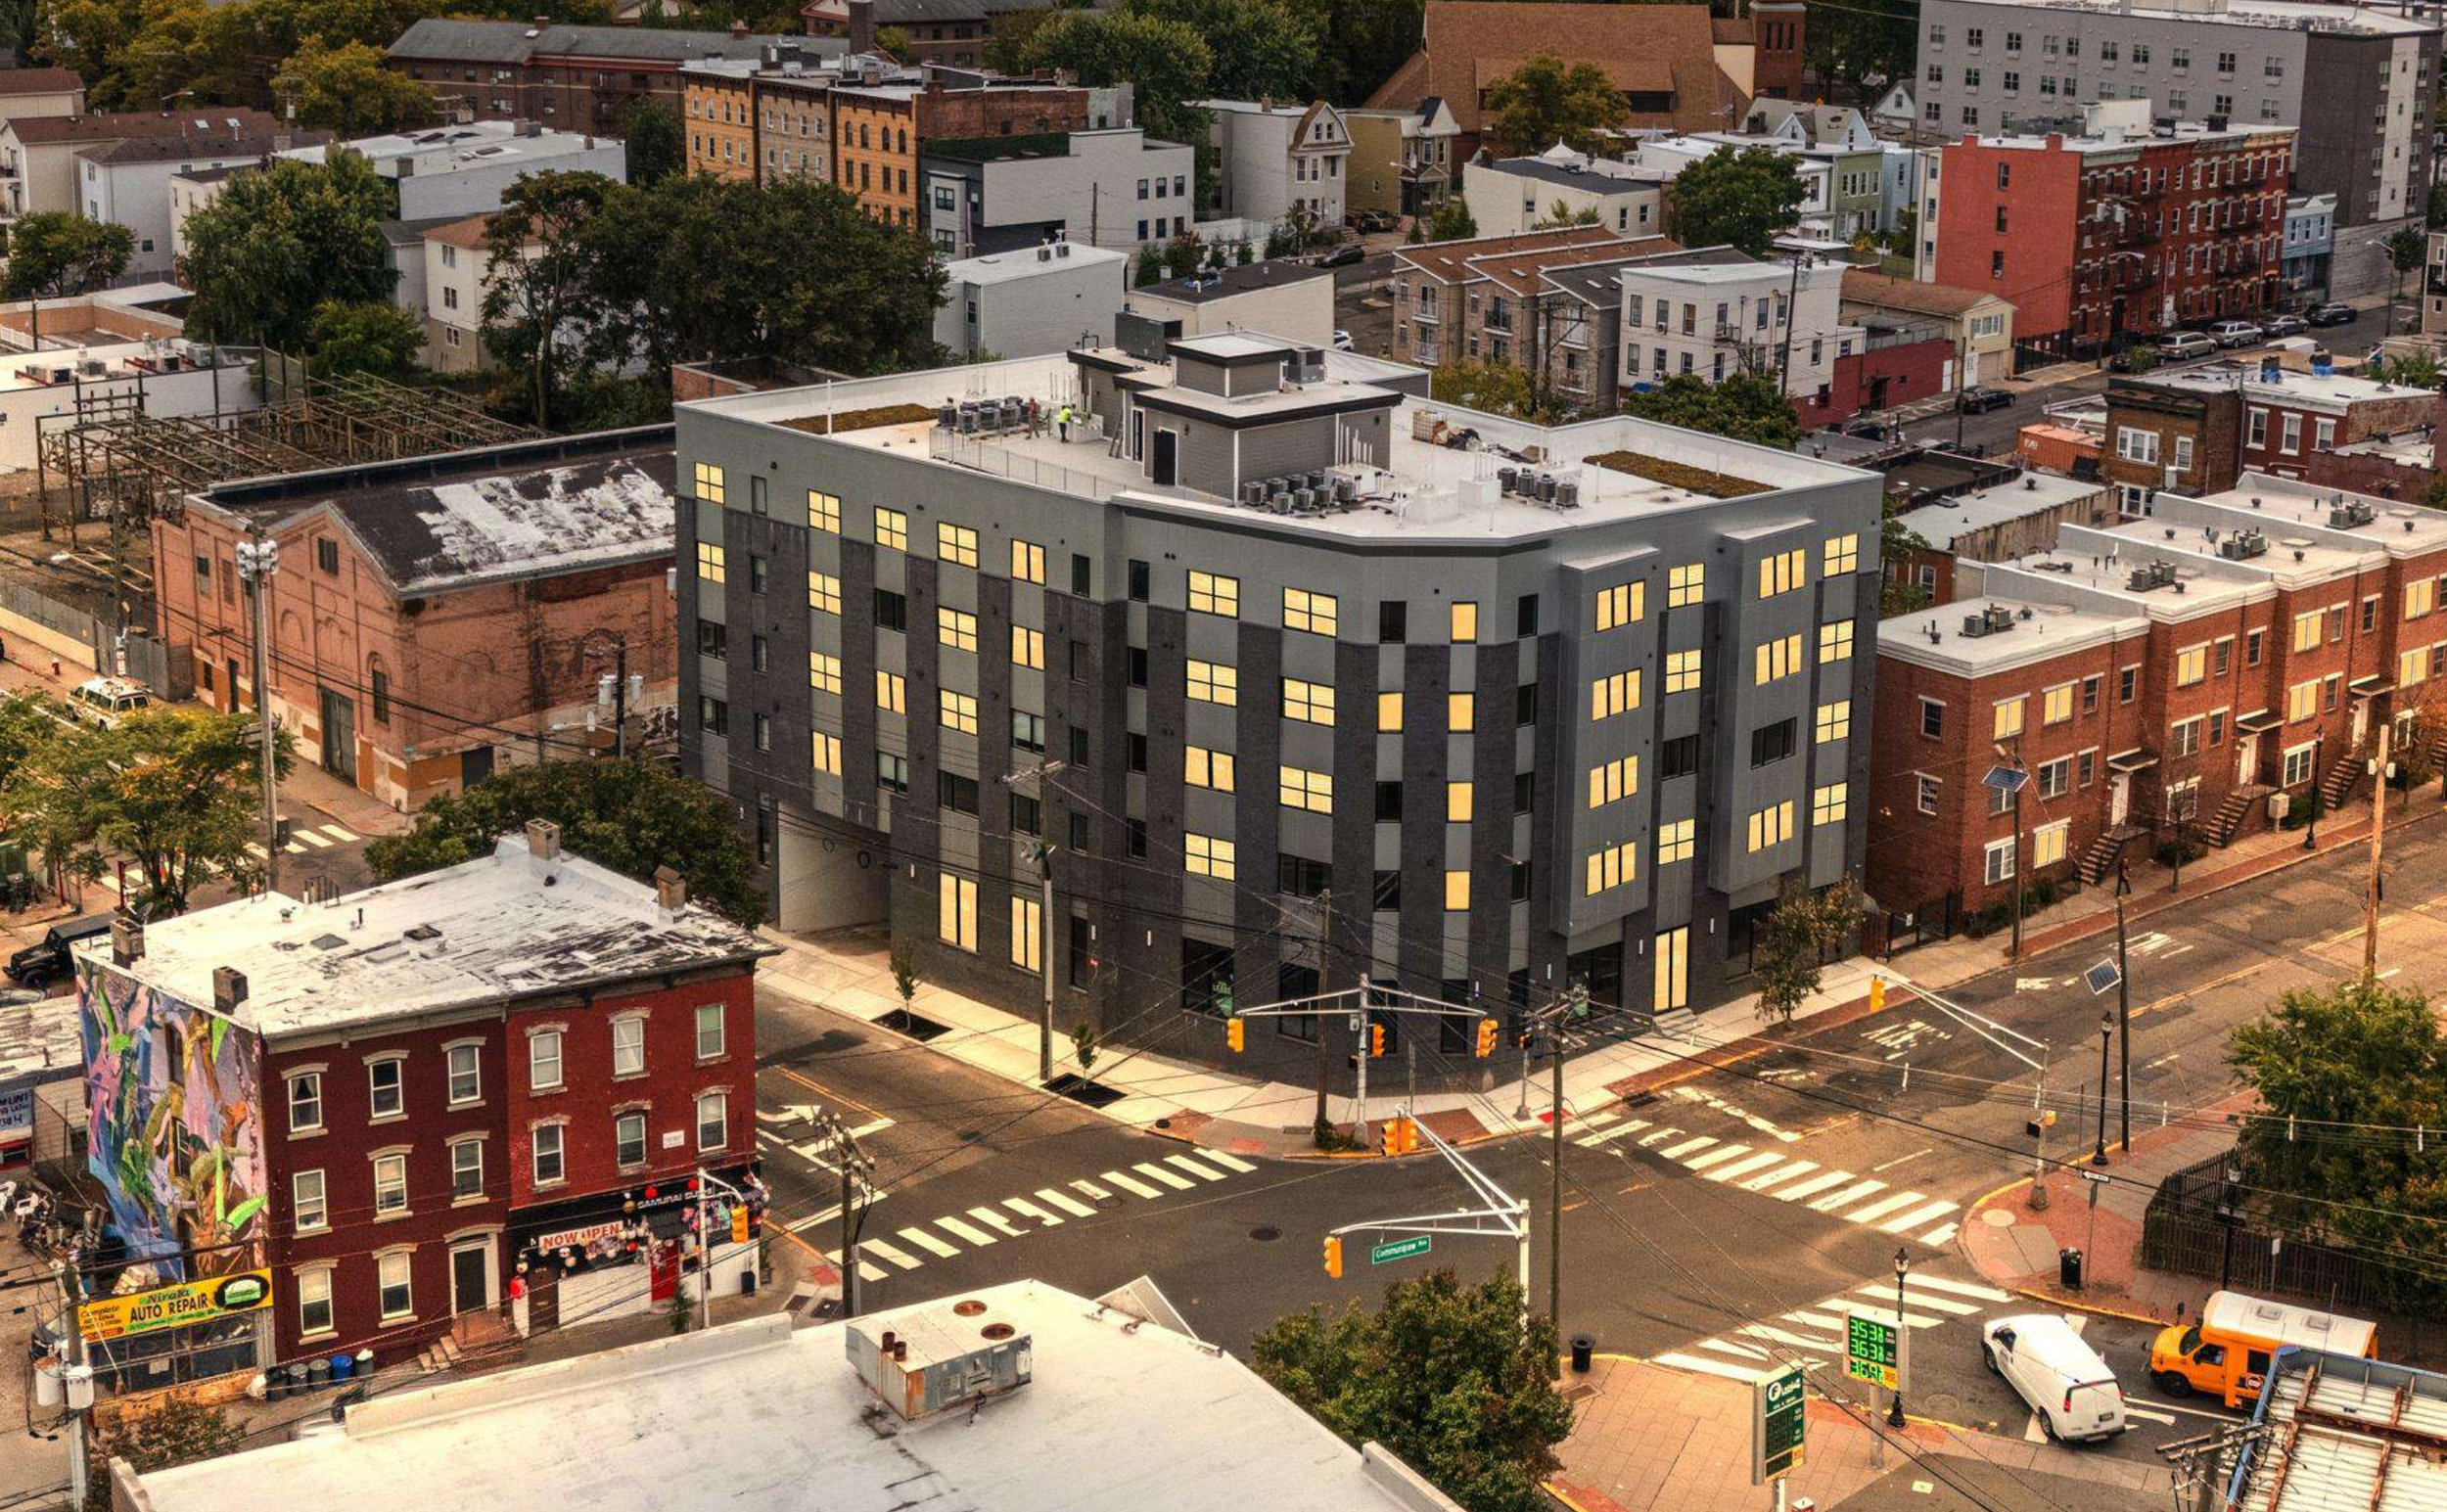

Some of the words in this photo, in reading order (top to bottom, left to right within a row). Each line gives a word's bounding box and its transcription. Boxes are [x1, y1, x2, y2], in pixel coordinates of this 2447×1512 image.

[543, 1231, 577, 1248] NOW
[129, 1304, 162, 1323] AUTO
[168, 1292, 208, 1315] REPAIR
